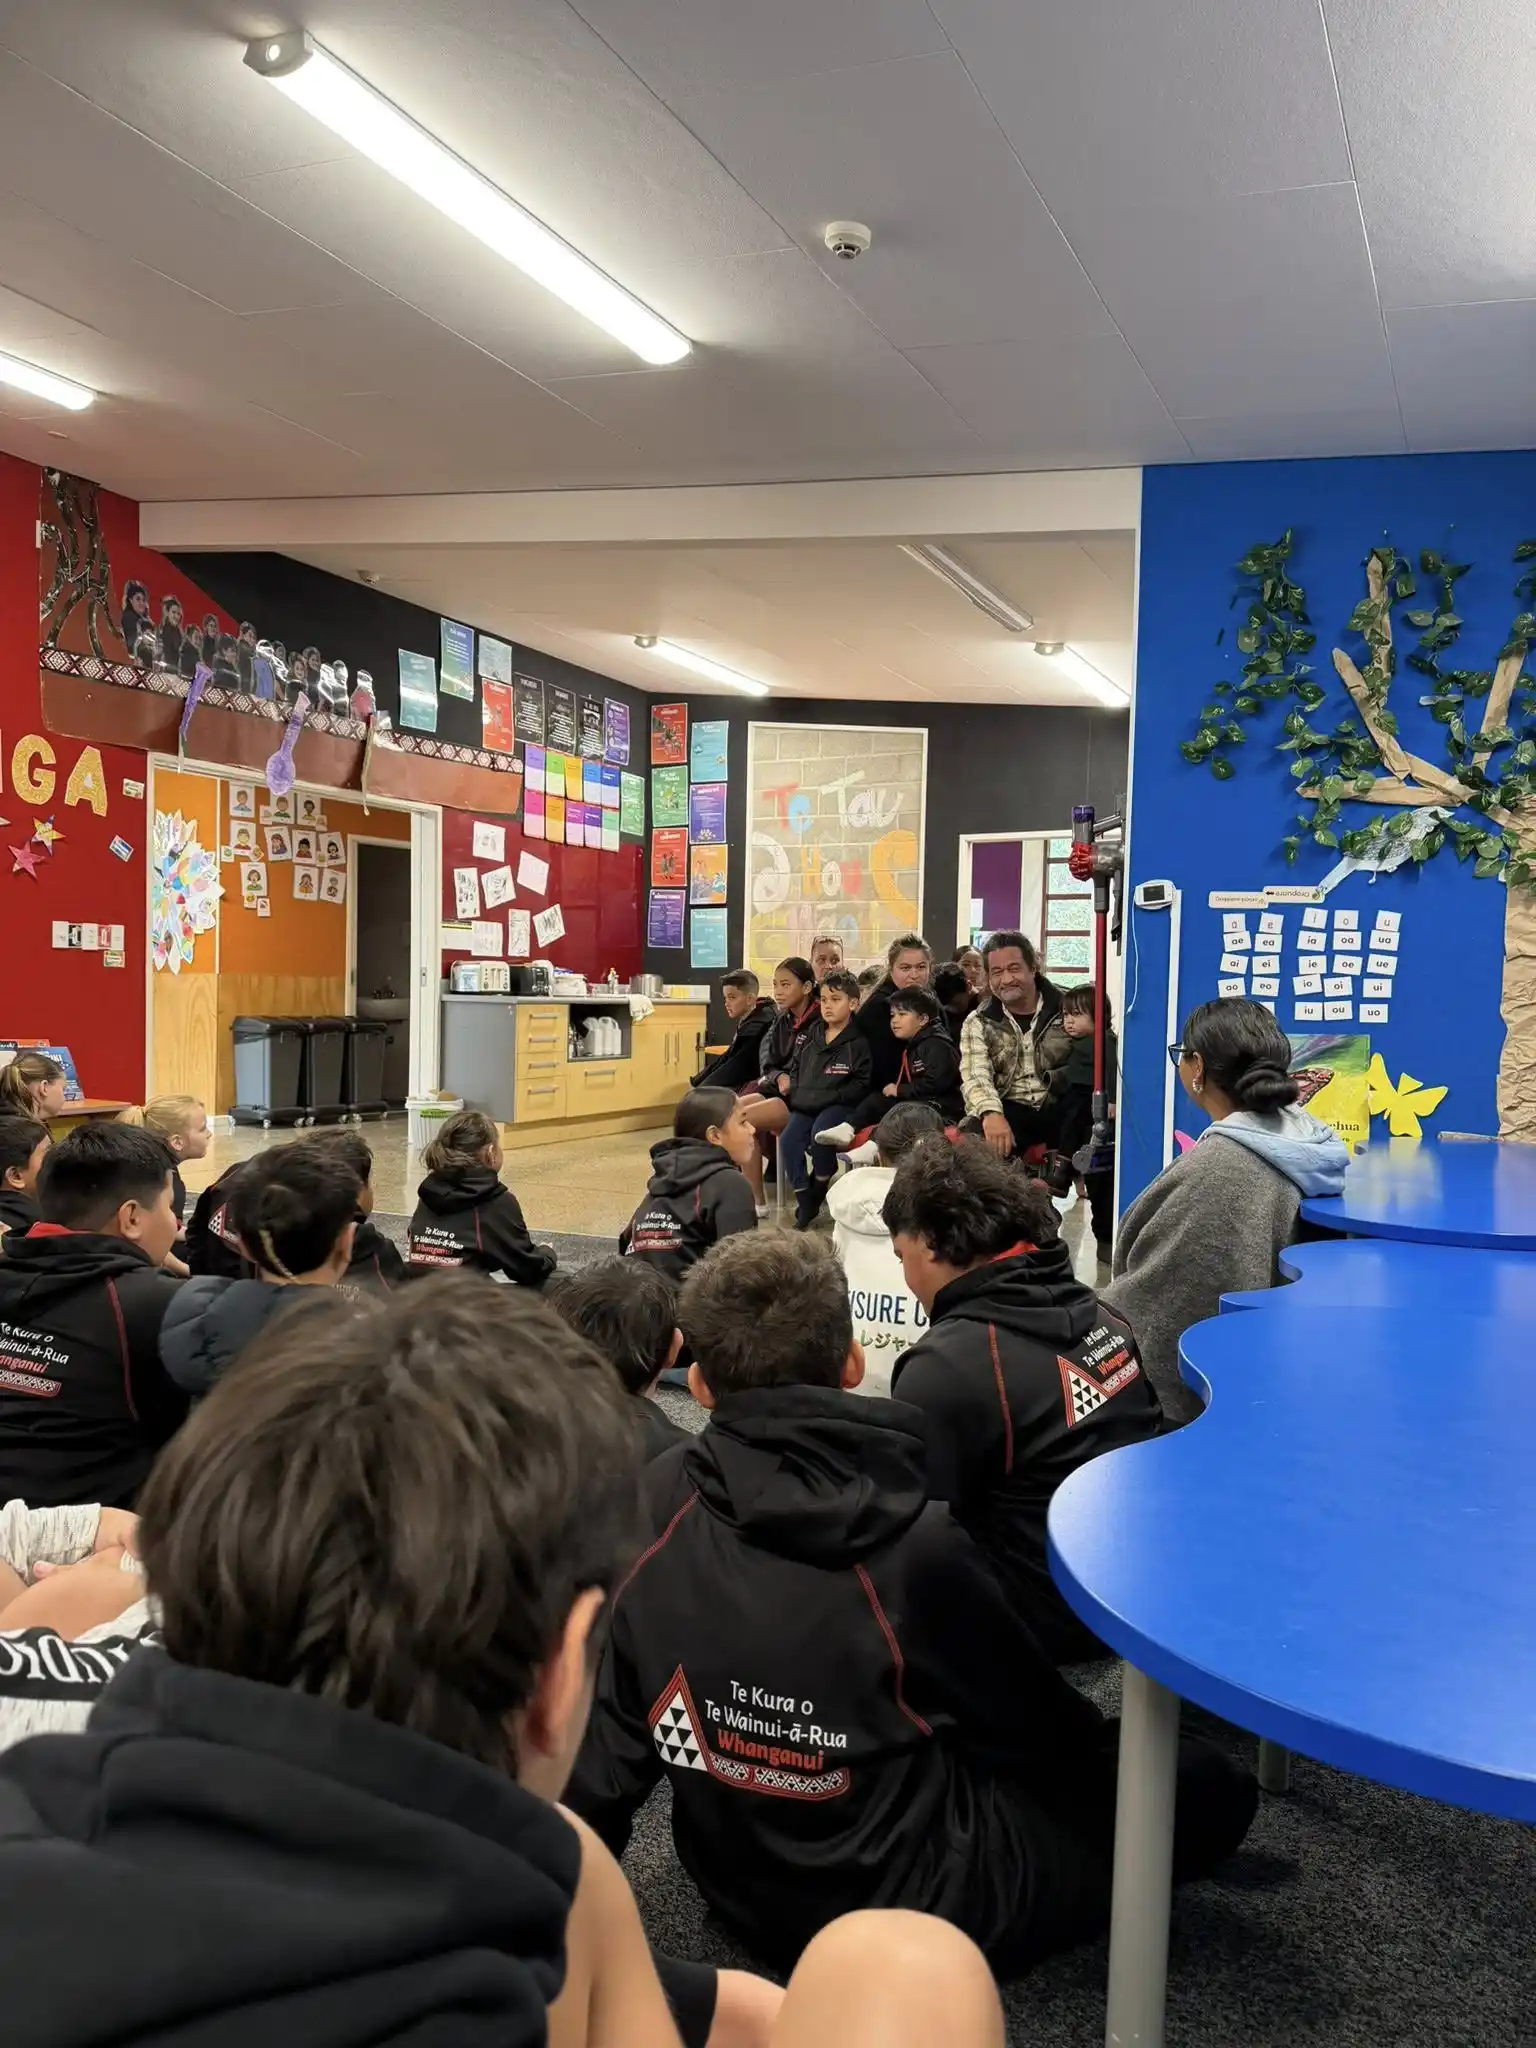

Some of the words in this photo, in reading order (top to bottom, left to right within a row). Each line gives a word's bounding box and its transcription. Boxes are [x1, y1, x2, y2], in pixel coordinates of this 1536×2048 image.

[0, 729, 108, 817] GA
[819, 770, 904, 828] Tau
[1231, 937, 1245, 945] ae
[1262, 938, 1275, 947] ea
[1340, 936, 1354, 944] oa
[1378, 936, 1392, 945] ua
[1230, 958, 1240, 968] ai
[1262, 959, 1271, 968] ei
[1308, 959, 1318, 968] ie
[1341, 960, 1355, 969] oe
[1375, 959, 1389, 969] ue
[1225, 983, 1239, 991] ao
[1259, 982, 1272, 991] eo
[1303, 979, 1313, 988] io
[1333, 980, 1344, 990] oi
[1373, 982, 1383, 992] ui
[1304, 1005, 1314, 1015] iu
[1332, 1006, 1345, 1015] ou
[1367, 1008, 1381, 1017] uo
[432, 1227, 449, 1238] Kura
[0, 1322, 11, 1335] Te
[12, 1326, 43, 1340] Kura
[44, 1335, 54, 1343] o
[1082, 1335, 1094, 1347] Te
[0, 1336, 70, 1365] ainui-ā-Rua
[0, 1354, 50, 1374] anganui
[1082, 1354, 1095, 1368] Te
[730, 1680, 748, 1703] Te
[751, 1686, 795, 1713] Kura
[801, 1700, 814, 1715] o
[704, 1699, 721, 1722] Te
[724, 1704, 848, 1749] Wainui-ā-Rua
[717, 1728, 825, 1771] Whanganui
